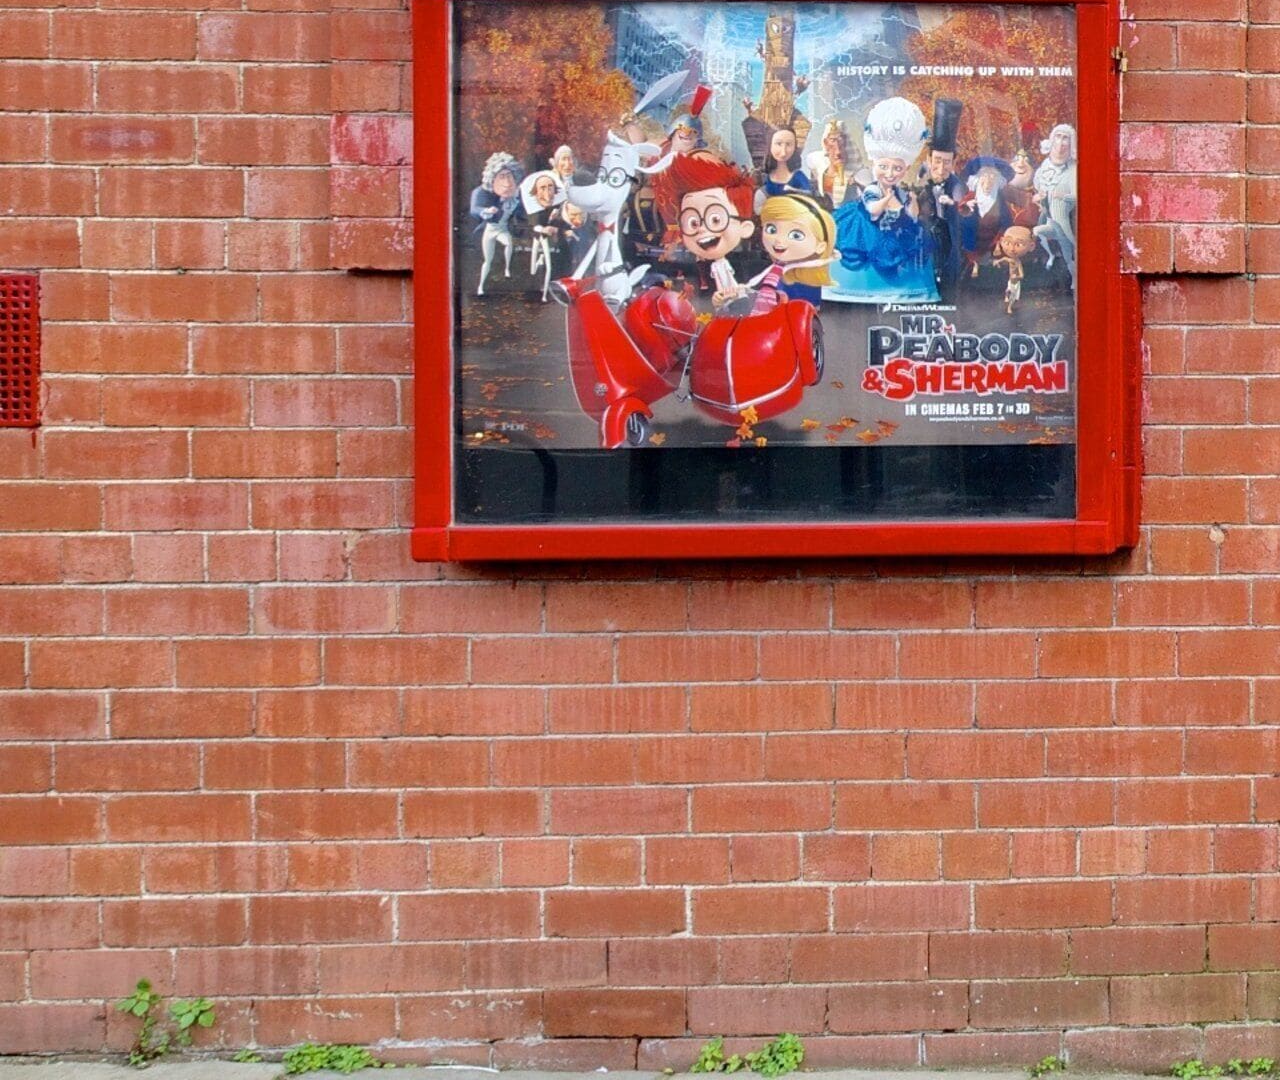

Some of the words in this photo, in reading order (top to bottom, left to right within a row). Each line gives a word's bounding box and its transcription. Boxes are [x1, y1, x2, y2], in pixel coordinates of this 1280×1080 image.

[837, 65, 889, 77] HISTORY
[893, 65, 906, 76] IS
[910, 65, 974, 77] CATCHING
[978, 66, 997, 77] UP
[1001, 66, 1035, 77] WITH
[1038, 66, 1073, 77] THEM
[869, 326, 1063, 367] PEABODY
[905, 404, 917, 416] IN
[921, 403, 970, 415] CINEMAS
[973, 403, 994, 415] FEB
[996, 403, 1003, 415] 7
[1015, 403, 1031, 415] 3D
